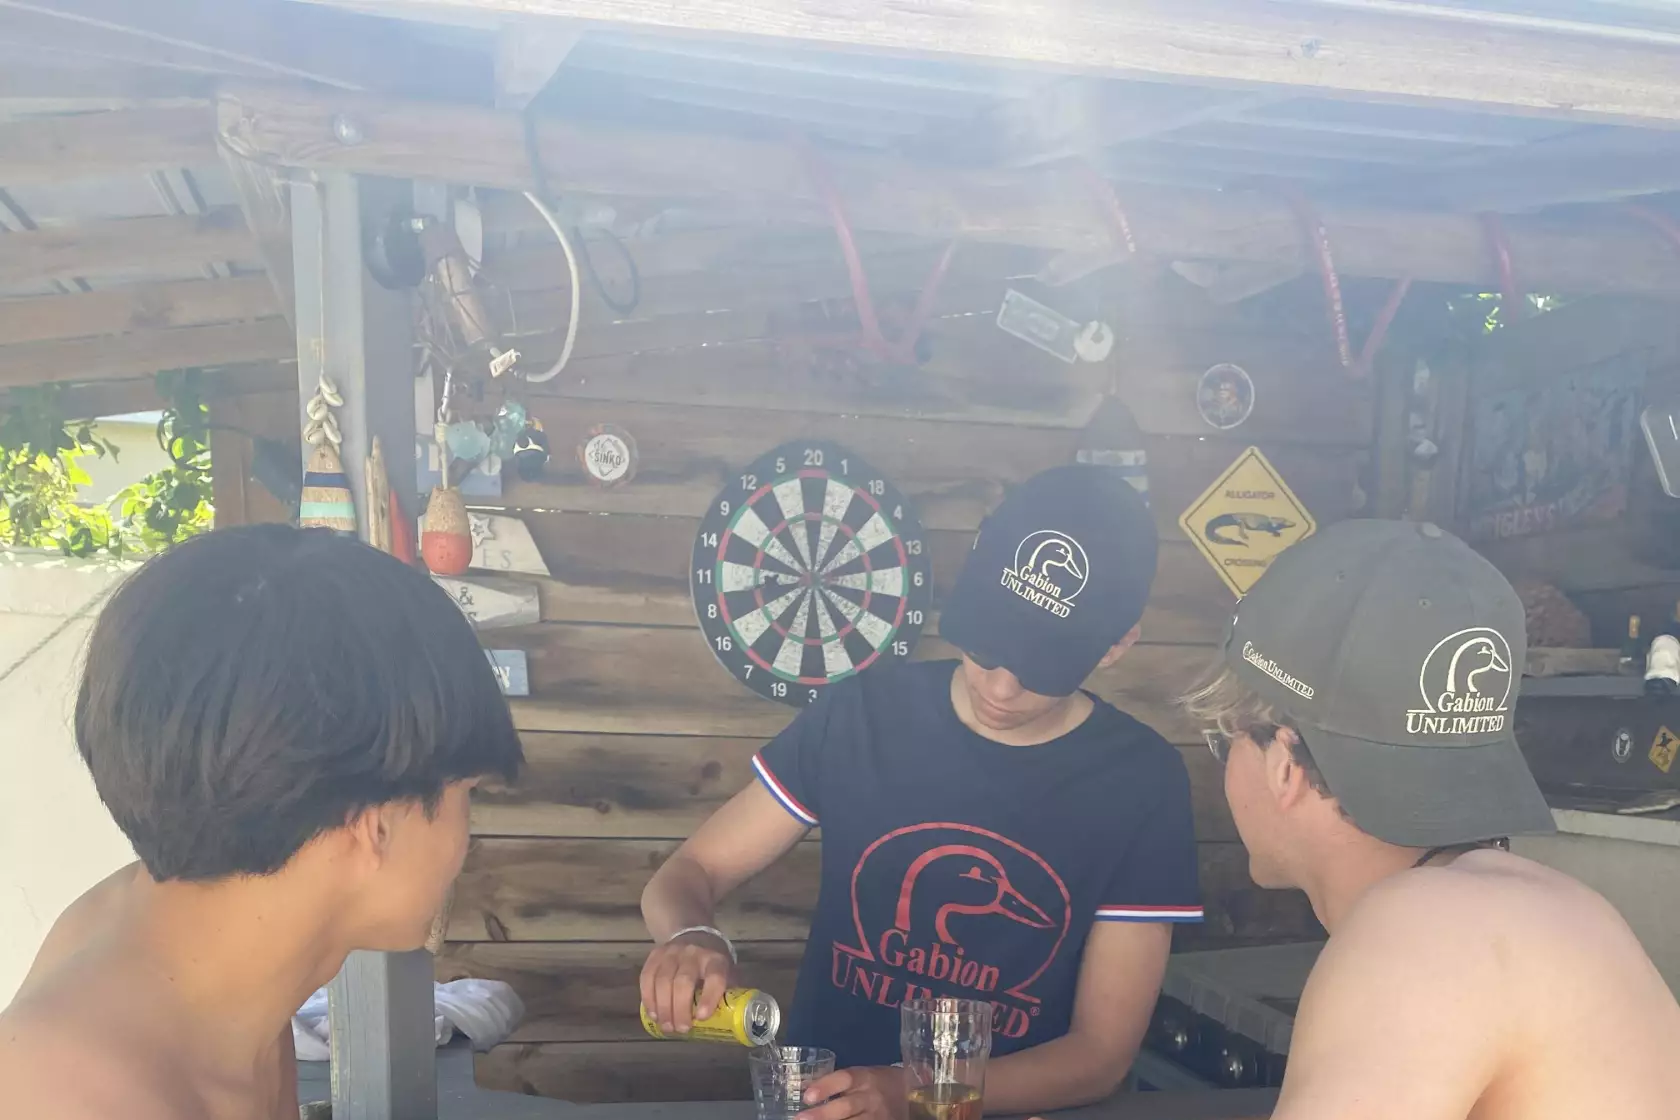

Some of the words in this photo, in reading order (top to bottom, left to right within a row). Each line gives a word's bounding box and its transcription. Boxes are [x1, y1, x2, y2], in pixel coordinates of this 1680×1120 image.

[775, 458, 785, 473] 5
[803, 449, 823, 467] 20
[841, 459, 848, 475] 1
[740, 474, 757, 491] 12
[868, 479, 885, 495] 18
[720, 501, 730, 516] 9
[893, 504, 903, 520] 4
[701, 532, 718, 548] 14
[906, 540, 922, 555] 13
[697, 570, 712, 584] 11
[913, 572, 923, 586] 6
[1020, 565, 1062, 598] Gabion
[1001, 569, 1071, 618] UNLIMITED
[707, 604, 717, 618] 8
[906, 610, 922, 624] 10
[715, 636, 732, 651] 16
[892, 641, 908, 656] 15
[744, 665, 753, 680] 7
[771, 682, 787, 697] 19
[808, 689, 817, 704] 3
[1438, 691, 1495, 712] Gabion
[1406, 713, 1504, 734] UNLIMITED
[880, 928, 1000, 991] Gabion
[831, 948, 1030, 1038] UNLIED
